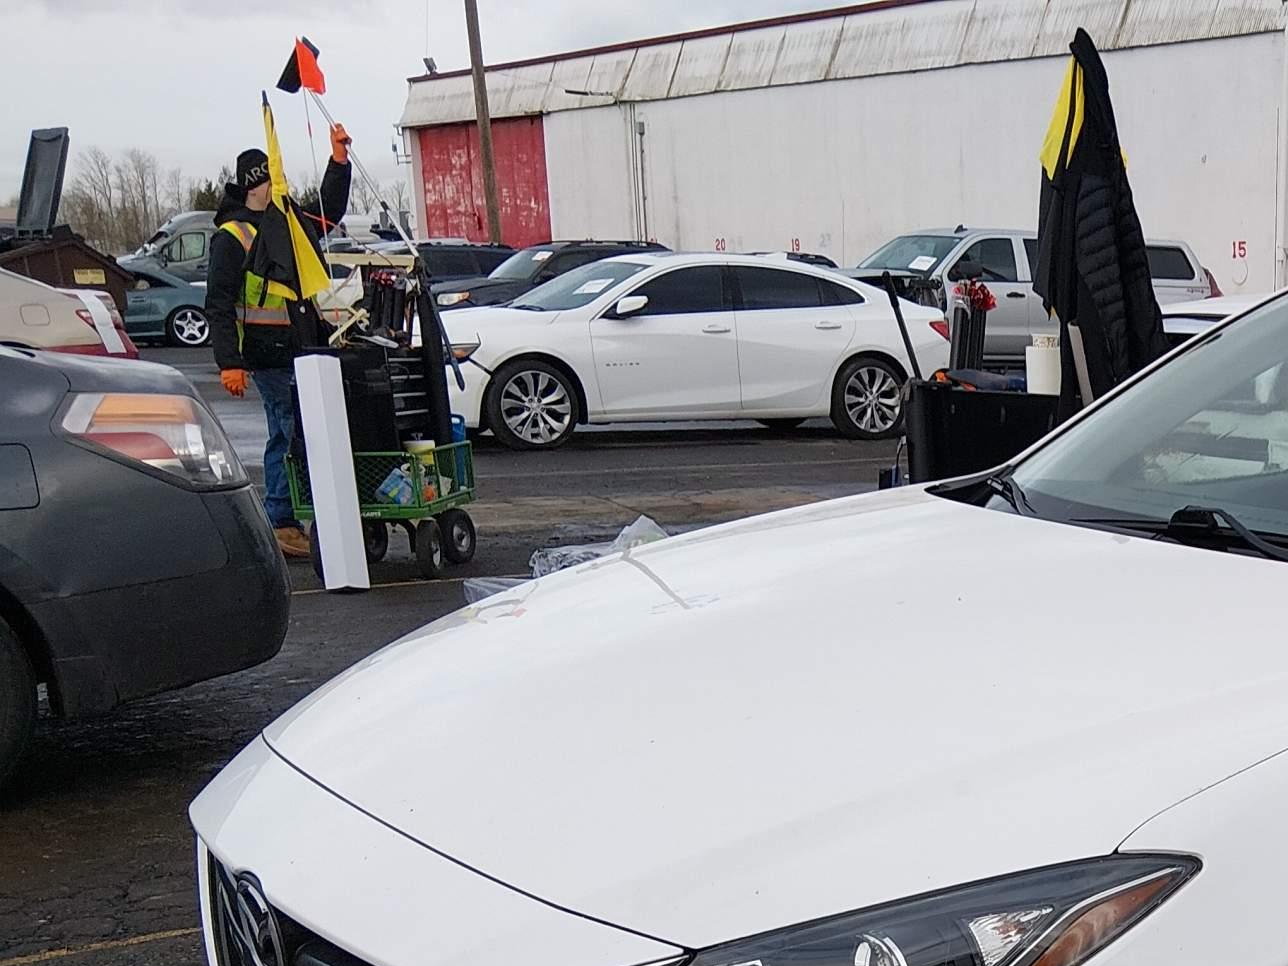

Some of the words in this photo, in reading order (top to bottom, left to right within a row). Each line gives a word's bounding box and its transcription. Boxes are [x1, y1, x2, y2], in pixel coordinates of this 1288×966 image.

[715, 238, 726, 251] 20
[791, 238, 800, 252] 19
[1232, 240, 1247, 259] 15
